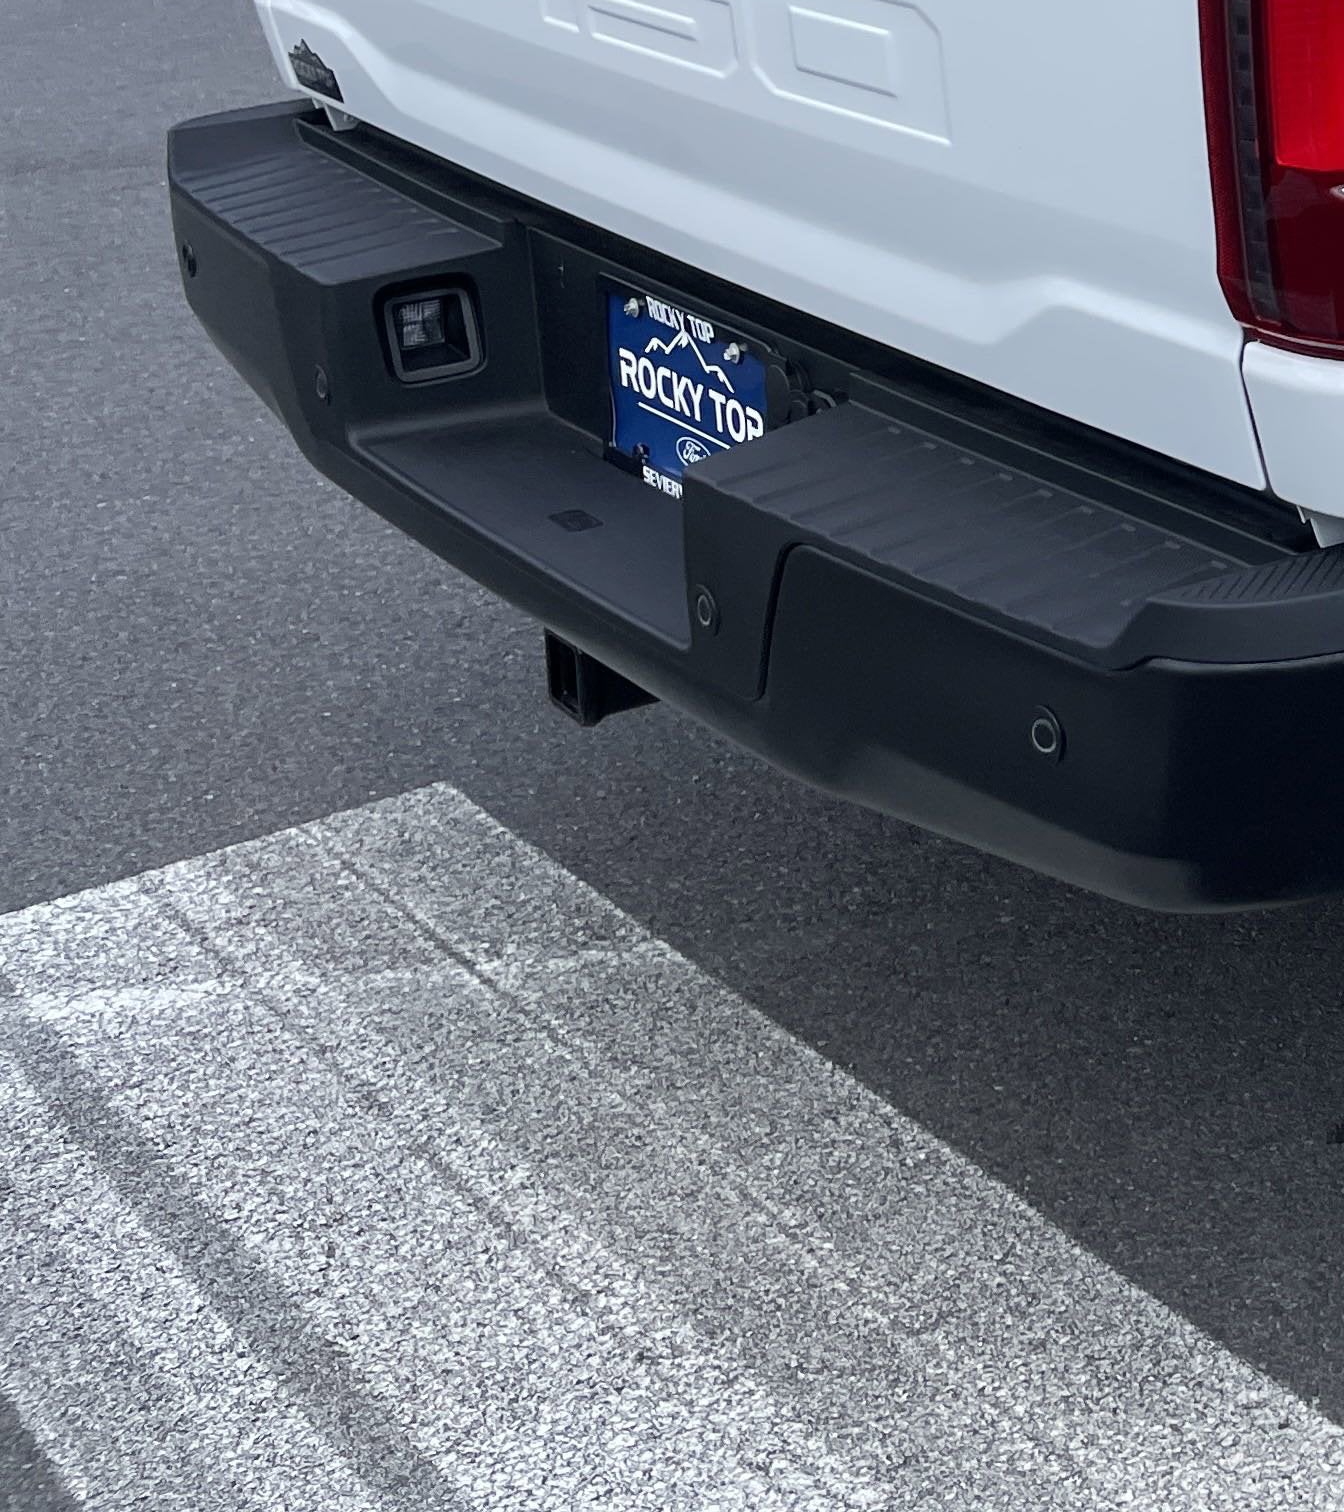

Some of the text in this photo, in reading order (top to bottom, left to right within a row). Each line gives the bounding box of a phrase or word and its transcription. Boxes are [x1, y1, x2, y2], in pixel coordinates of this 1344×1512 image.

[645, 295, 715, 344] ROCKY TOP
[618, 347, 764, 443] ROCKY TOP
